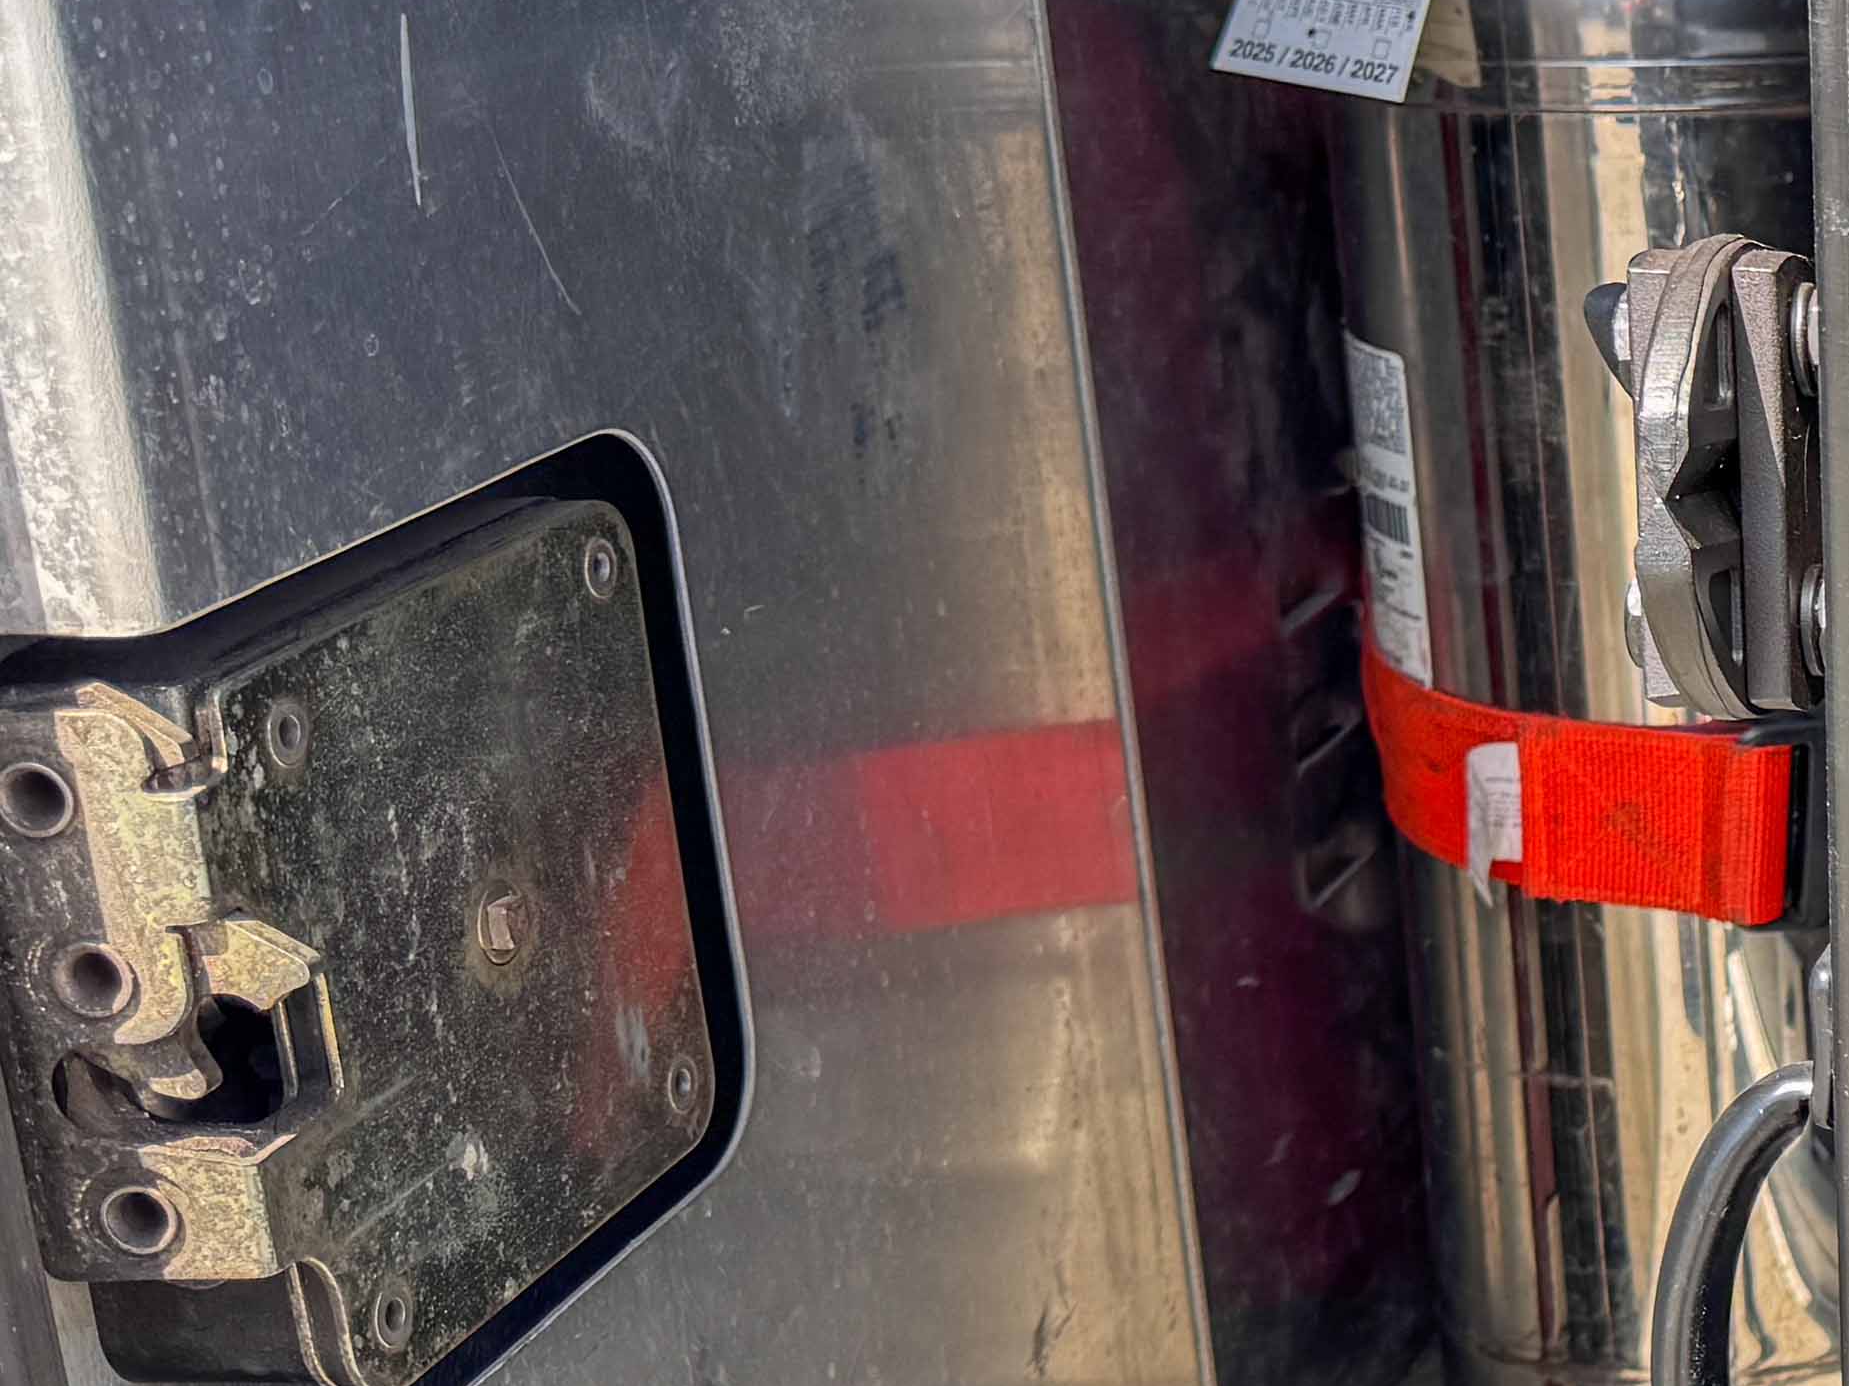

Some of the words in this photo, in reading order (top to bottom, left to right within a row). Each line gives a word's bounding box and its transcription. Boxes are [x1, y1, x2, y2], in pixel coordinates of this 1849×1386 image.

[1229, 38, 1278, 63] 2025
[1289, 49, 1337, 75] 2026
[1350, 59, 1400, 86] 2027
